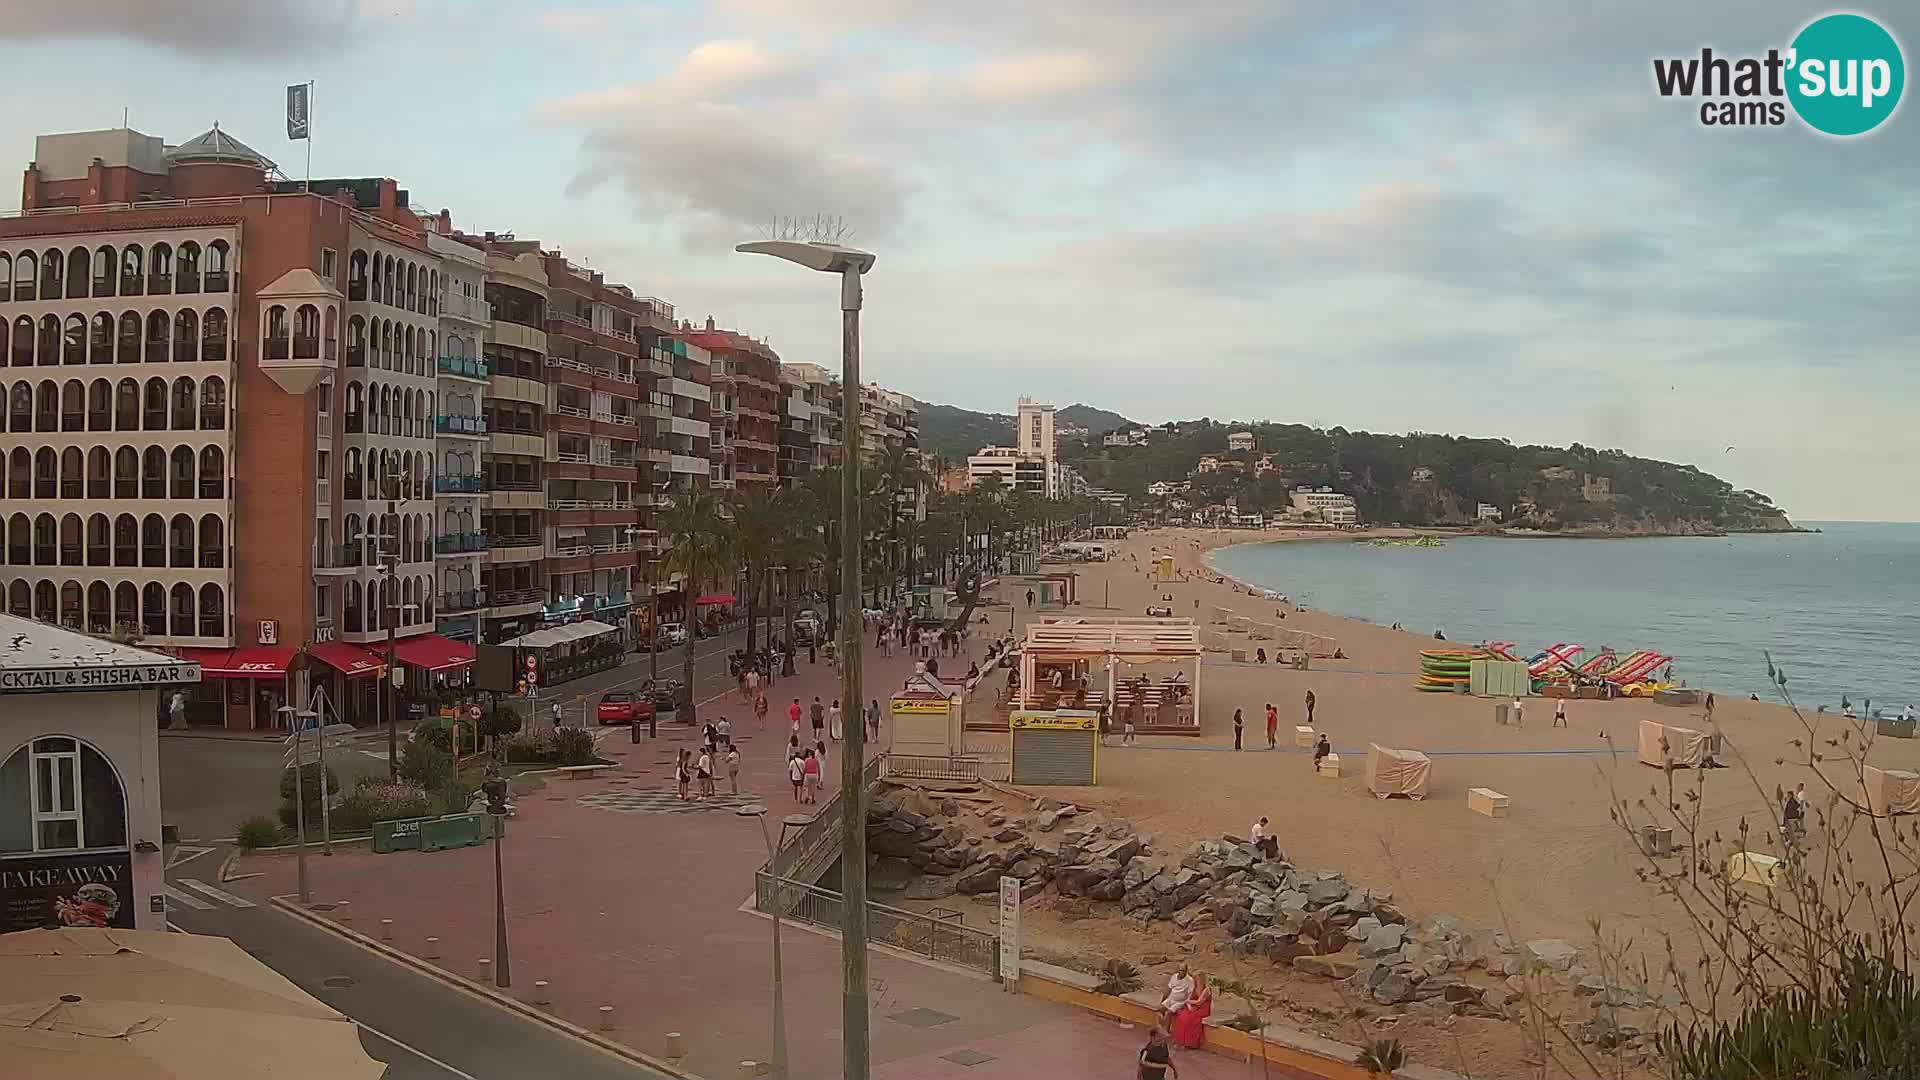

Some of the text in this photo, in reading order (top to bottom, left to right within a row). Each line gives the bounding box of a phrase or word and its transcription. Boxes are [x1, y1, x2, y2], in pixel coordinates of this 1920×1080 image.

[316, 627, 334, 643] KFC
[239, 662, 276, 670] KFC
[2, 667, 180, 687] CKTAIL & SHISHA BAR
[2, 864, 122, 889] TAKEAWAY
